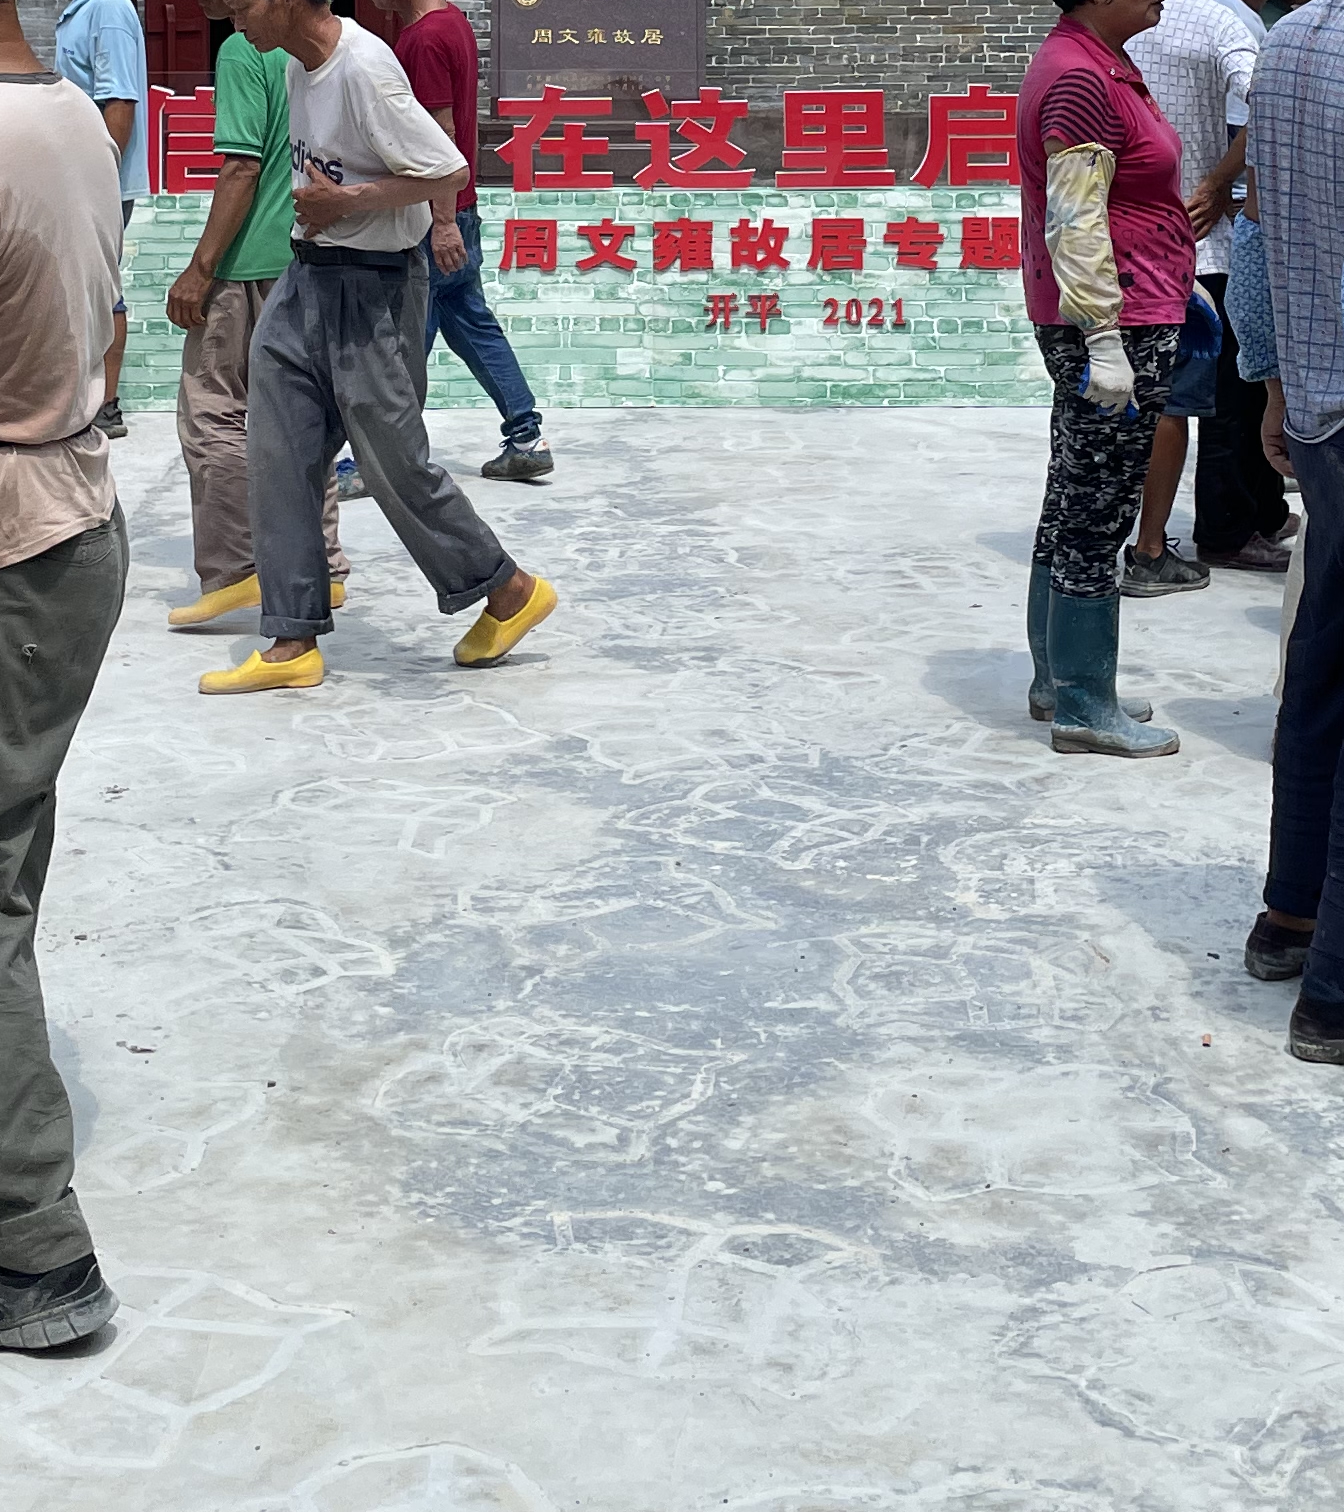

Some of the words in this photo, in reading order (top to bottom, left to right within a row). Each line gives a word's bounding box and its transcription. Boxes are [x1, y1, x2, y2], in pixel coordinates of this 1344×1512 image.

[531, 28, 664, 45] 周文雍故居
[499, 216, 1022, 272] 周文雍故居专题
[704, 293, 782, 332] 开平
[823, 298, 908, 327] 2021
